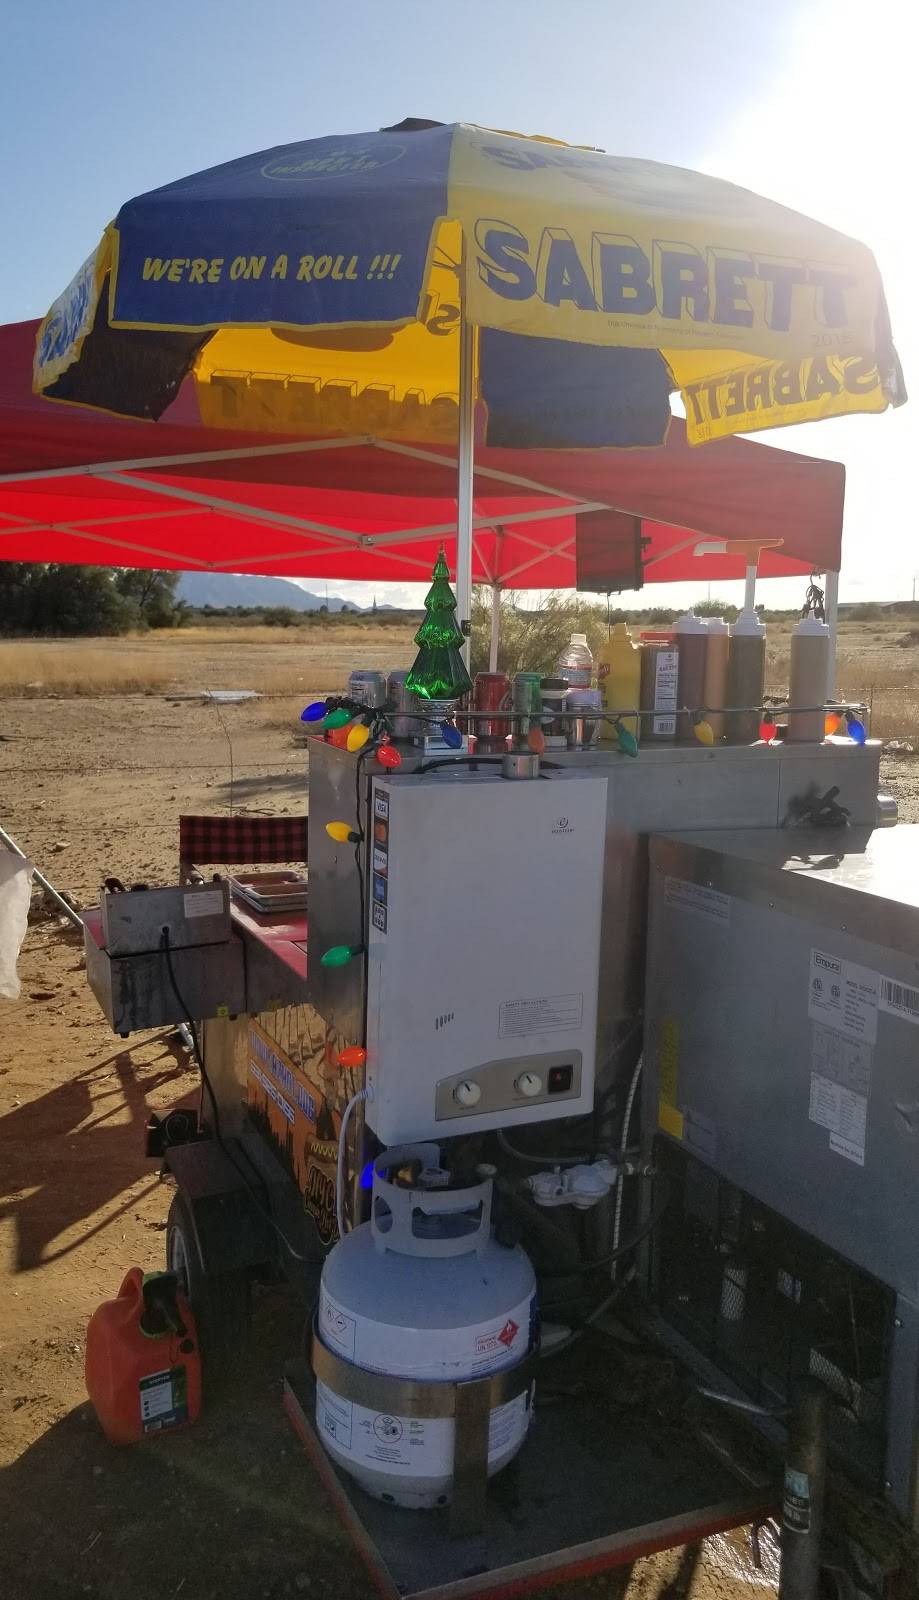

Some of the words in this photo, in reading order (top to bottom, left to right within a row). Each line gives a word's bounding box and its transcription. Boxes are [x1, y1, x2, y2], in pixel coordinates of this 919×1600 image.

[142, 257, 224, 284] WE'RE
[230, 256, 266, 280] ON
[270, 254, 288, 280] A
[296, 254, 358, 283] ROLL
[366, 254, 401, 280] !!!
[474, 218, 858, 332] SABRETT
